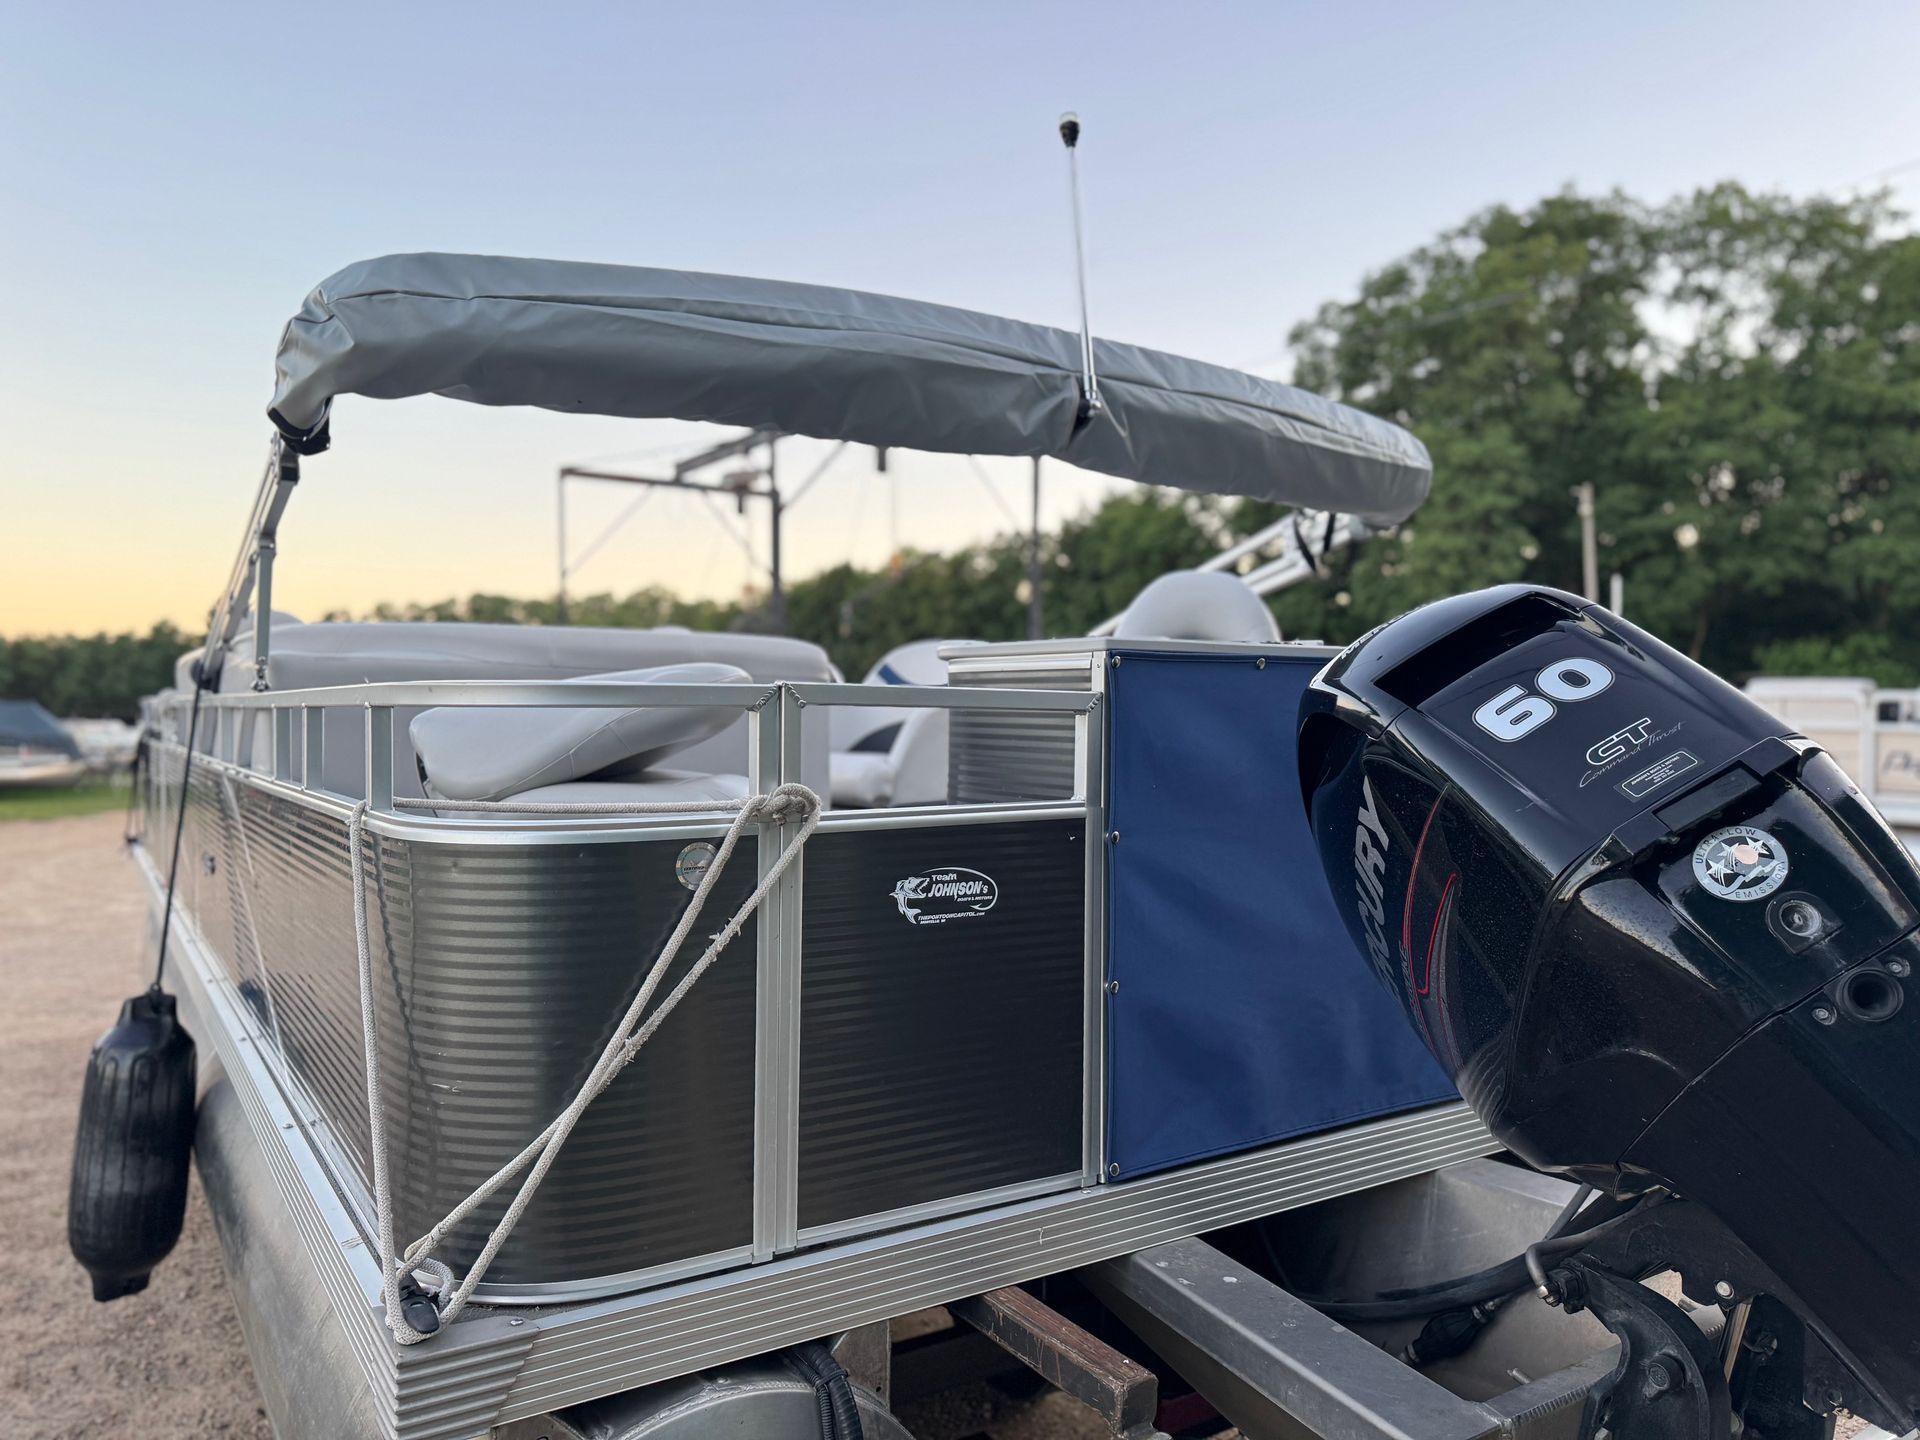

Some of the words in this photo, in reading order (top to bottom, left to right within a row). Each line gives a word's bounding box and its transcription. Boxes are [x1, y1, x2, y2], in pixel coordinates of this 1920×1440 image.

[1471, 656, 1616, 743] 60
[1580, 742, 1641, 787] Command
[1648, 720, 1688, 747] Thrust
[1586, 717, 1651, 766] GT
[1695, 833, 1720, 864] ULTRA
[1726, 827, 1757, 837] LOW
